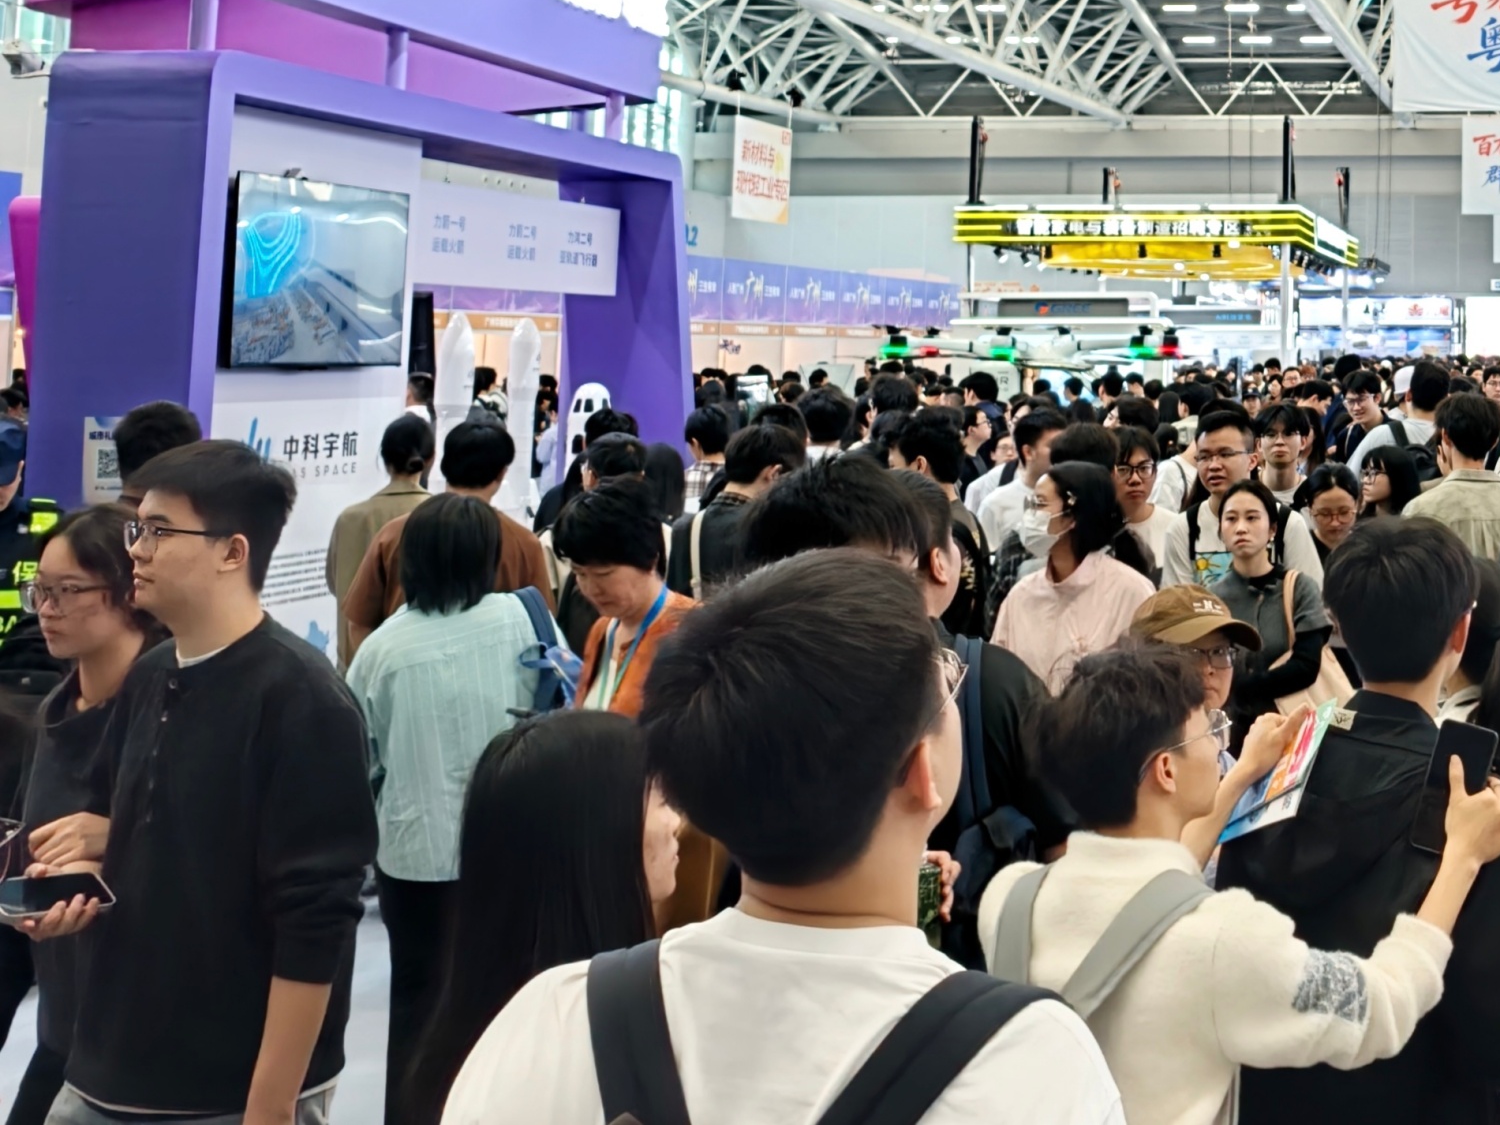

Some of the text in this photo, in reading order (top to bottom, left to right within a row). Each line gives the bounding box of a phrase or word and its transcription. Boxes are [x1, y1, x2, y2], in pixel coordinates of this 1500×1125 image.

[283, 432, 359, 461] 中科宇航
[315, 462, 357, 478] SPACE
